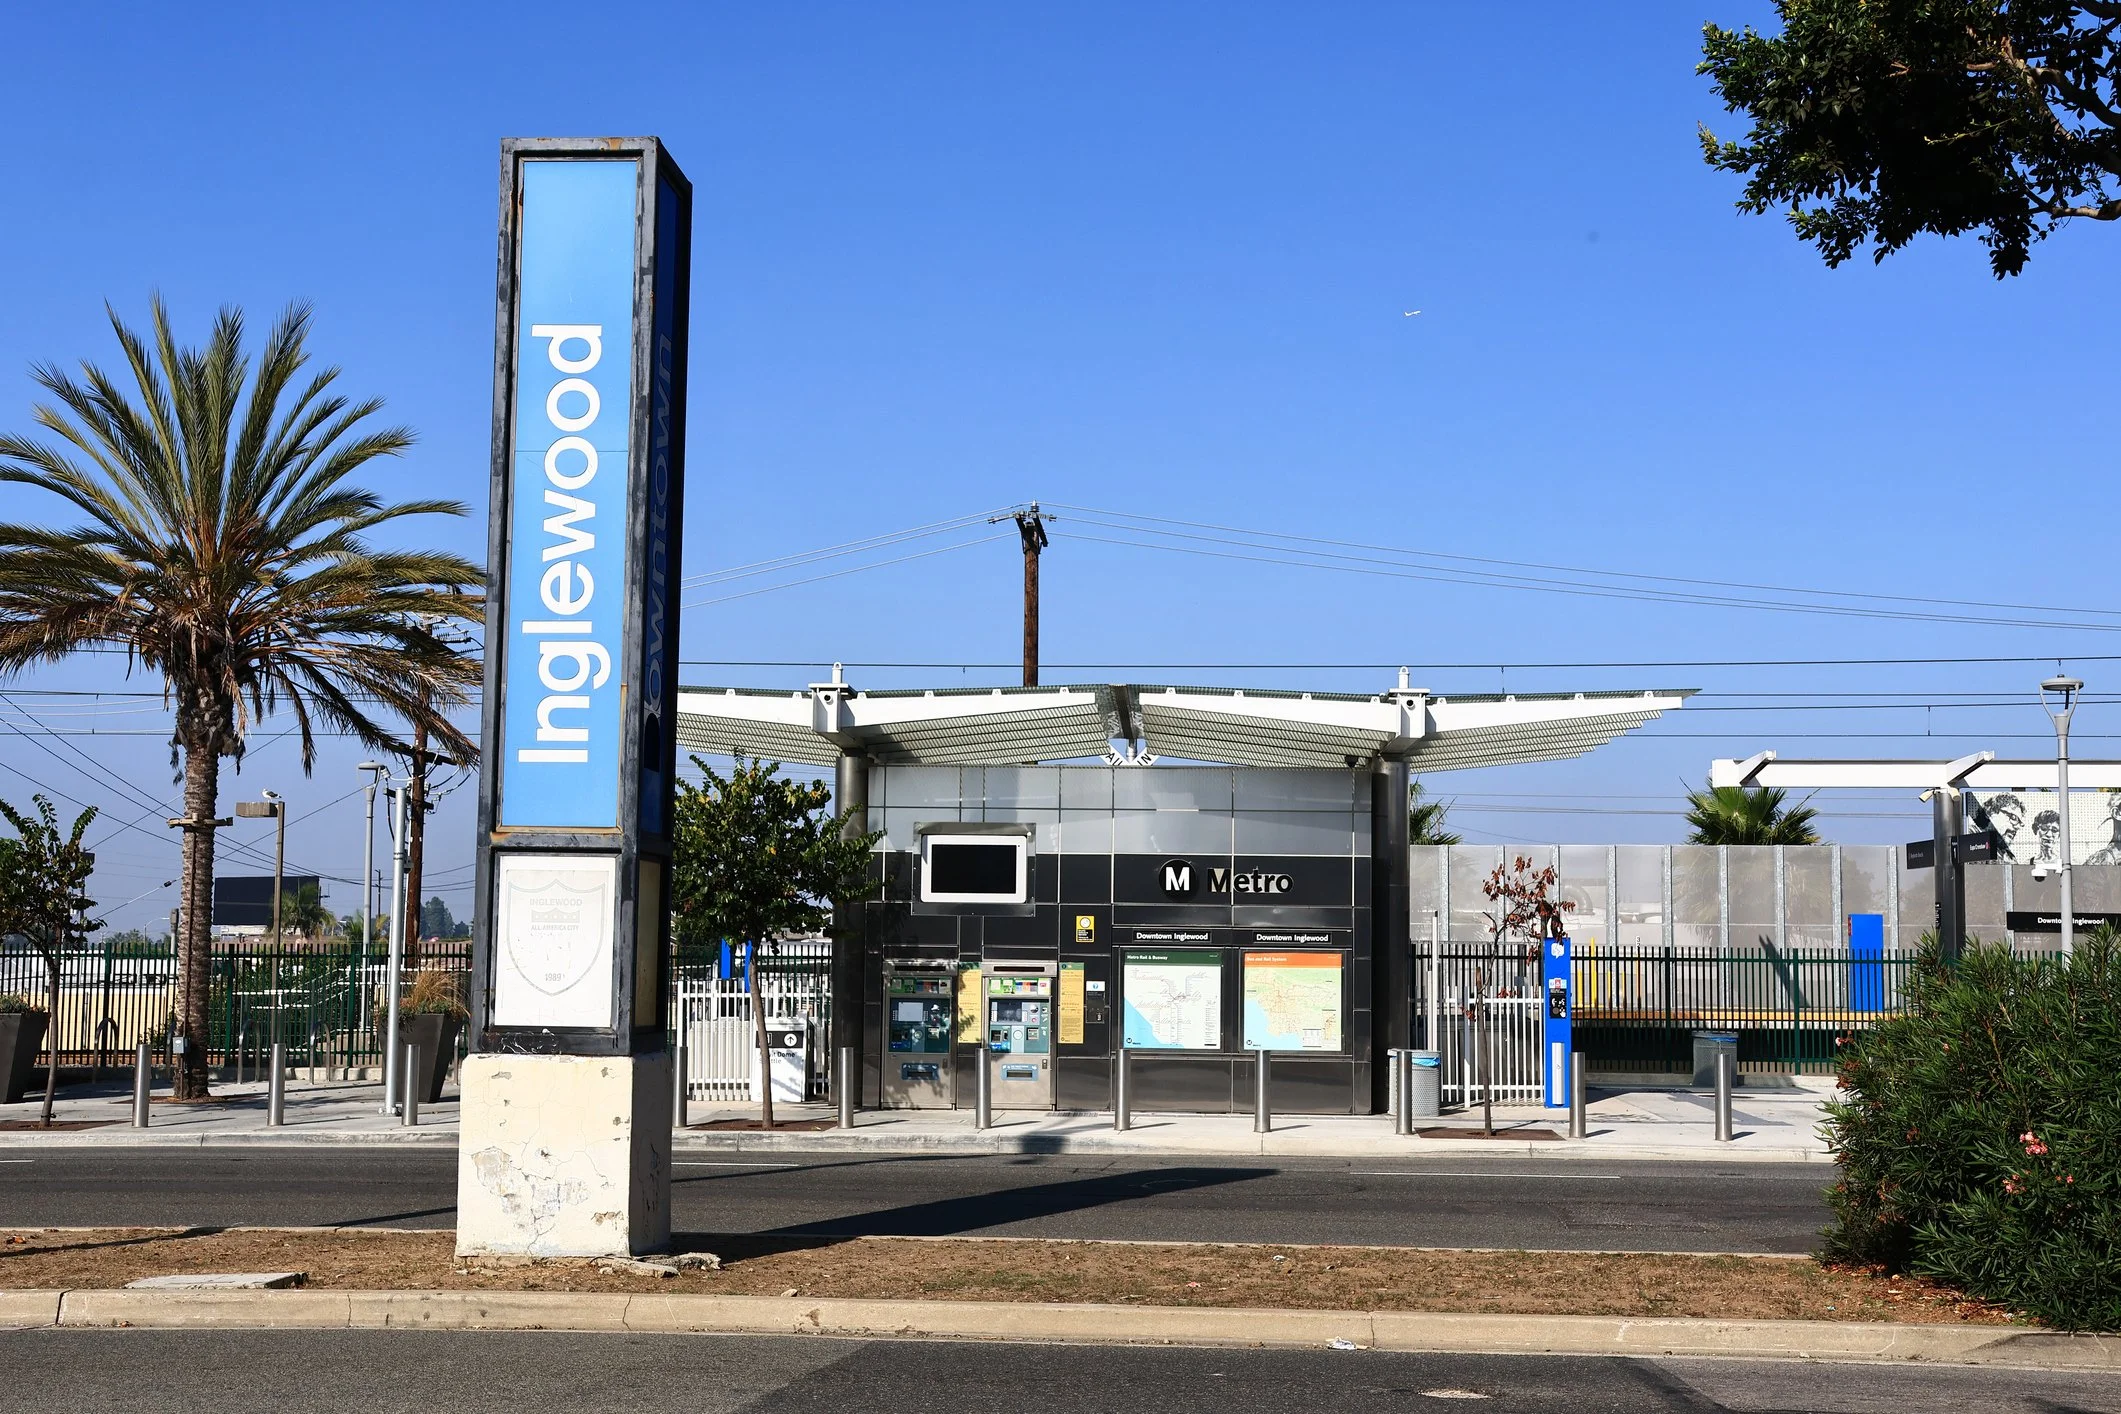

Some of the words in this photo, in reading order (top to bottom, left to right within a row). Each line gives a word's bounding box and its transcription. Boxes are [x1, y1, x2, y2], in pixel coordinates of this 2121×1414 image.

[519, 323, 611, 764] Inglewood
[1207, 866, 1294, 894] Metro
[529, 898, 583, 906] INGLEWOOD
[2037, 917, 2062, 925] Downto
[1136, 932, 1172, 941] Downtown
[1174, 932, 1208, 943] Inglewood
[1256, 933, 1292, 942] Downtown
[1294, 934, 1328, 944] Inglewood
